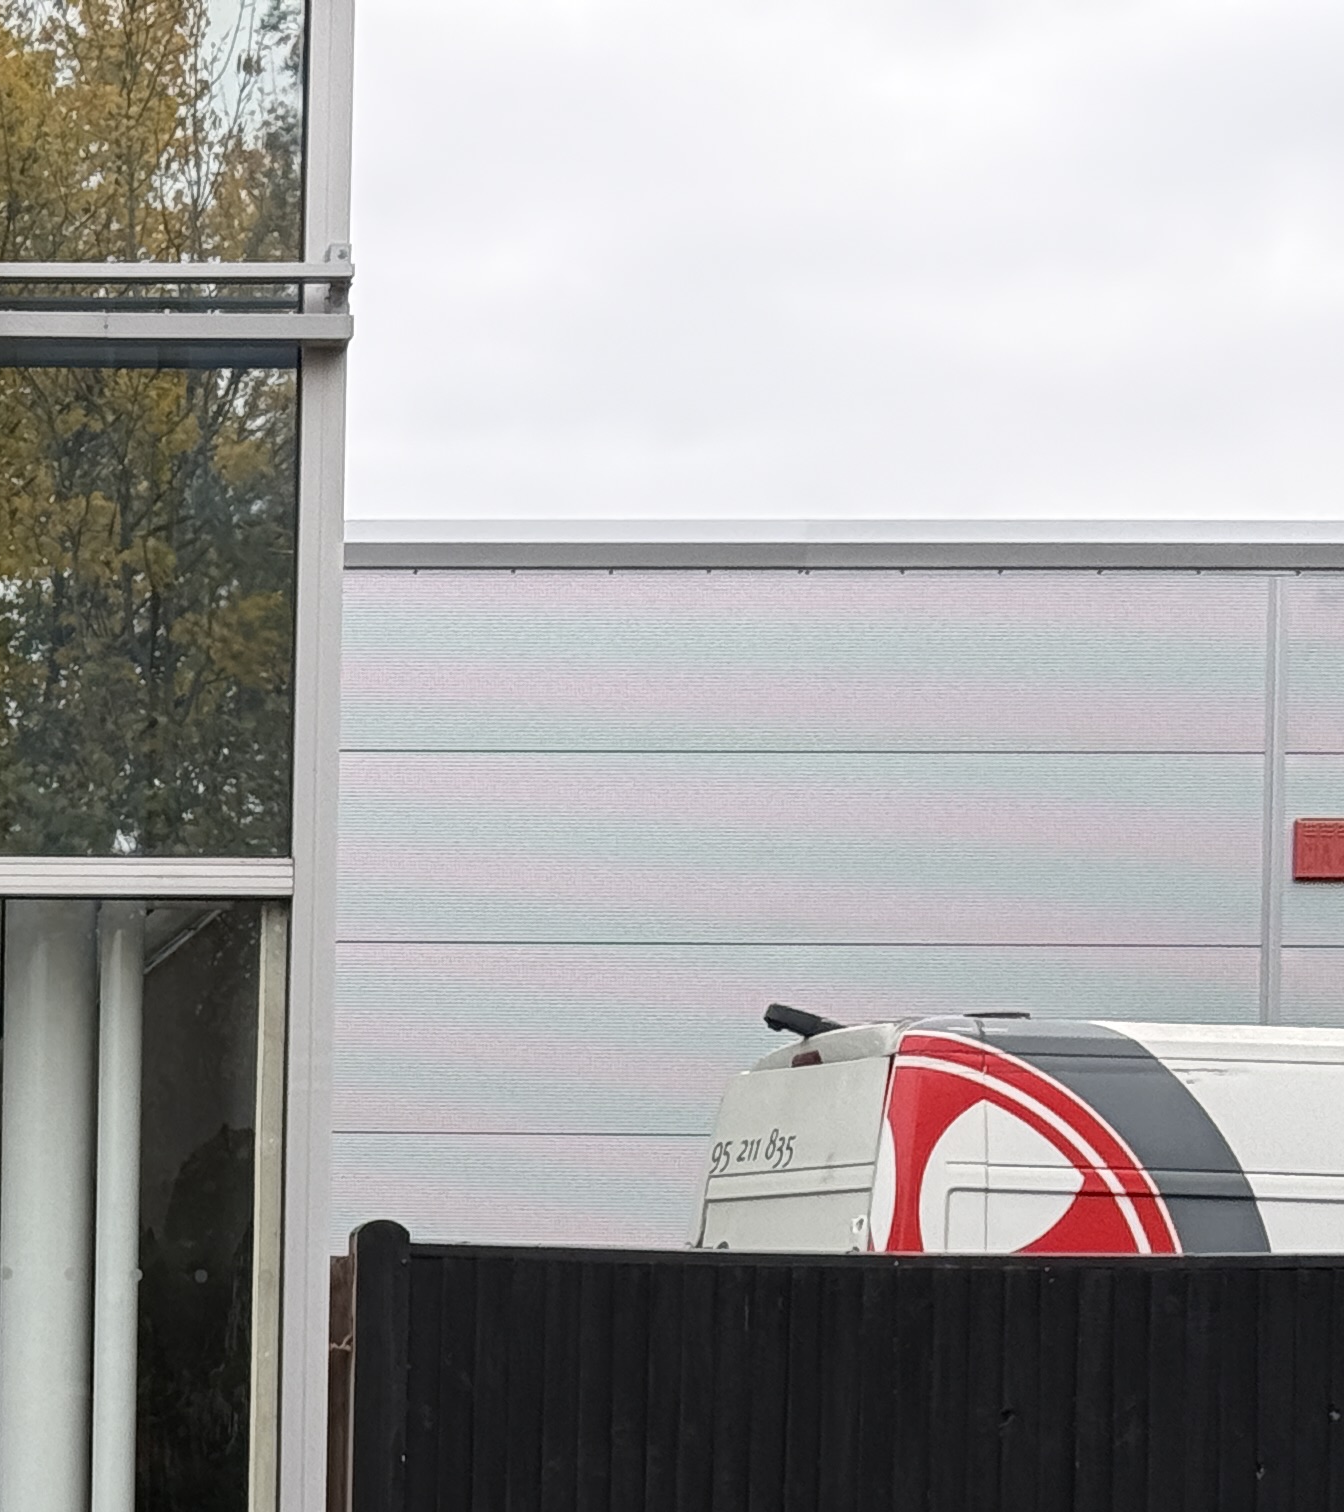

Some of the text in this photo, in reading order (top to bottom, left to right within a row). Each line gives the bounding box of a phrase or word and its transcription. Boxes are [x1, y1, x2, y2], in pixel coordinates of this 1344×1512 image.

[709, 1128, 797, 1174] 95 211 835
